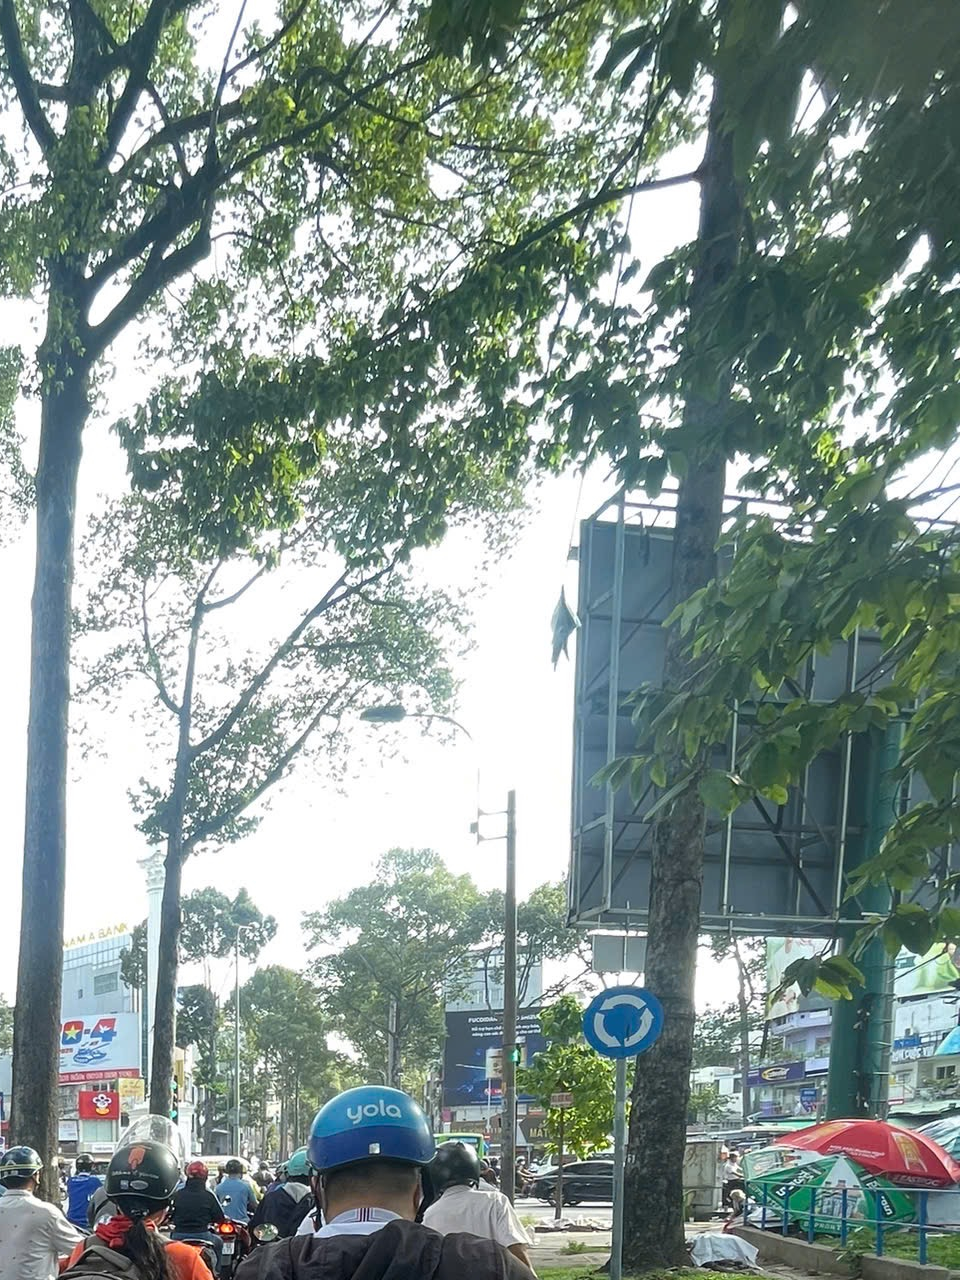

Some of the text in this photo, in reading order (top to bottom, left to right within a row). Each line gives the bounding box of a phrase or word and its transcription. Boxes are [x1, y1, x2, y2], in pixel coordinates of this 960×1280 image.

[98, 922, 128, 939] BANK
[62, 1018, 117, 1045] 0-4
[346, 1099, 402, 1125] yola
